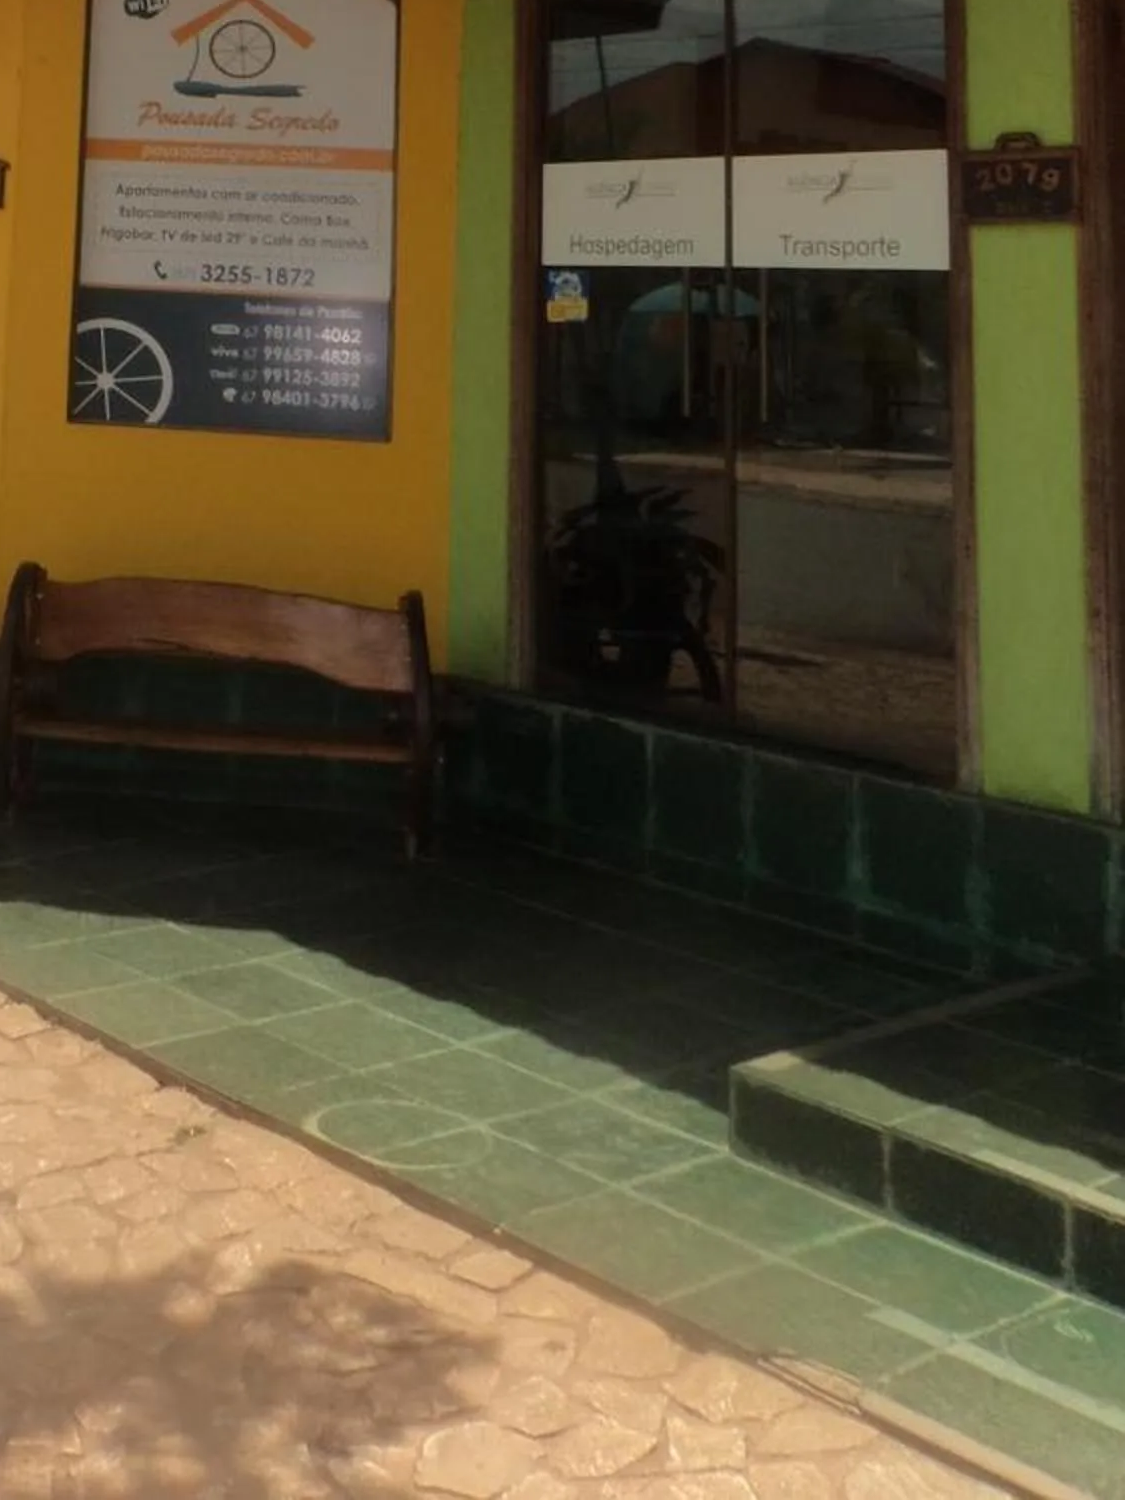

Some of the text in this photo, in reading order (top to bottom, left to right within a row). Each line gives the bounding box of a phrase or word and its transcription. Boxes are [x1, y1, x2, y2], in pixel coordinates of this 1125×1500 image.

[137, 100, 236, 130] Pousada
[974, 162, 1061, 193] 2079
[569, 231, 694, 260] Hospedagem
[777, 233, 902, 260] Transporte
[200, 263, 316, 287] 3255-1872
